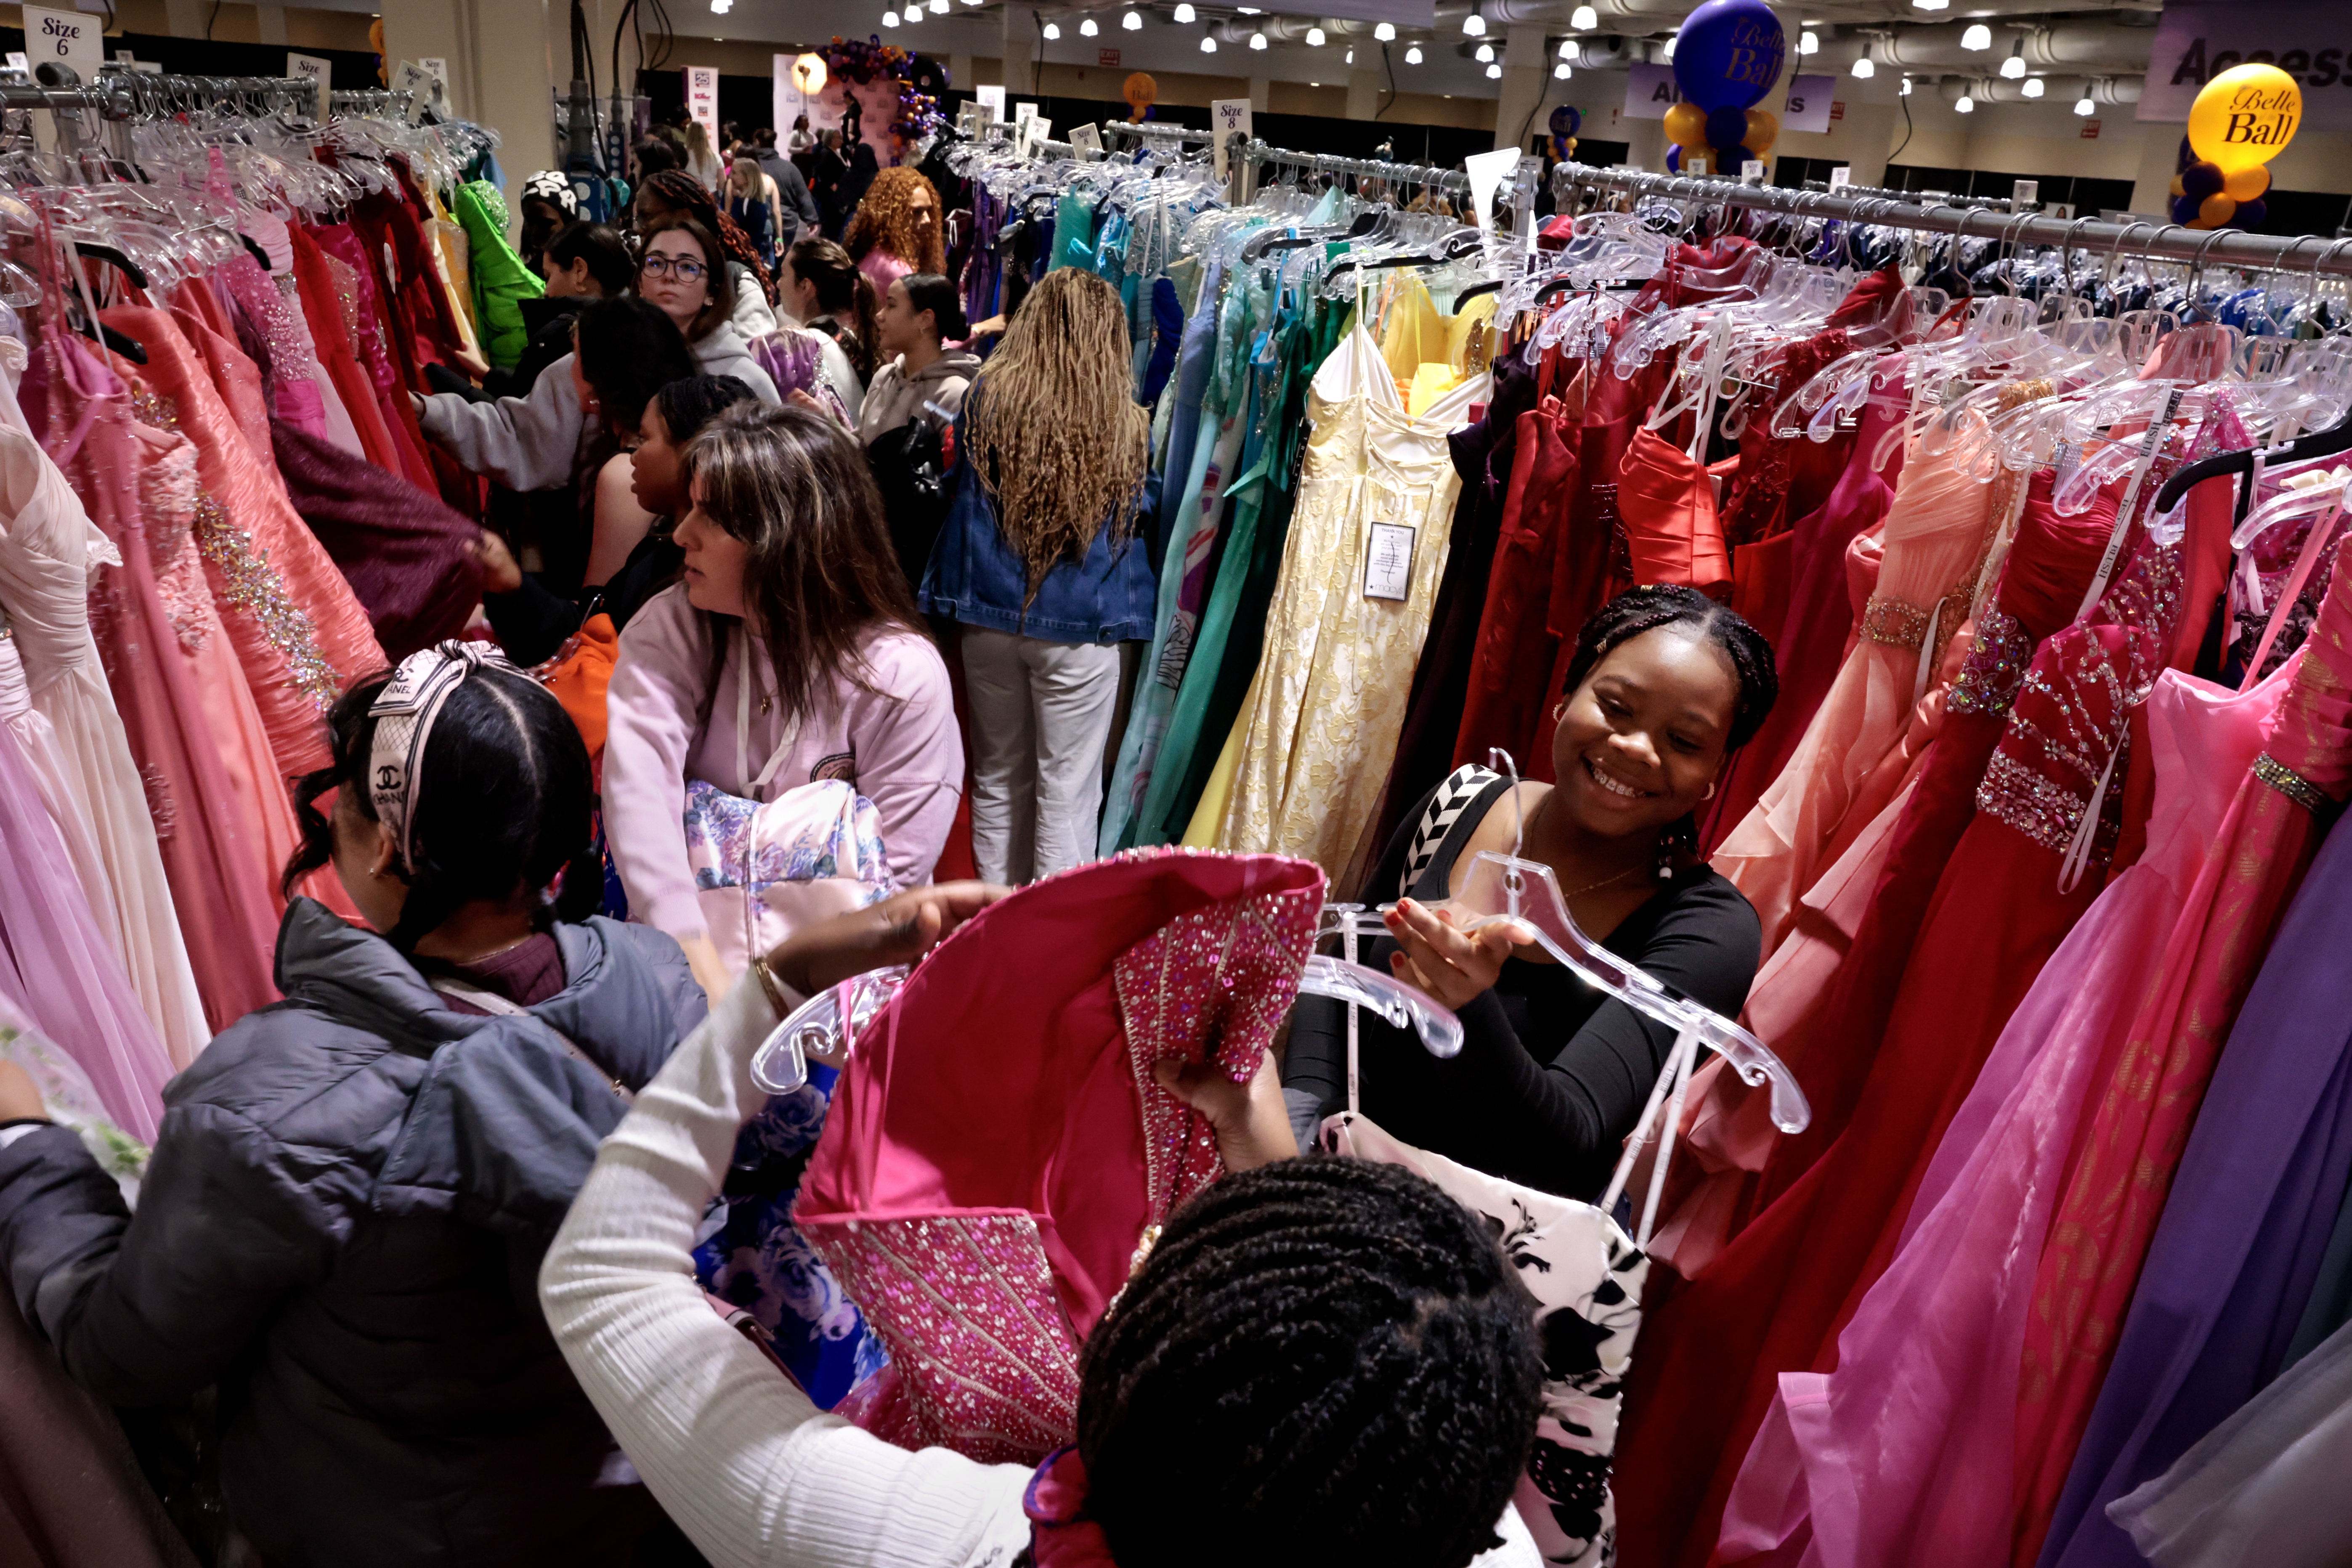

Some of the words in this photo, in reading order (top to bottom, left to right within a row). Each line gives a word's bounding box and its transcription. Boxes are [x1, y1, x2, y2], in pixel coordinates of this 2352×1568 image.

[42, 17, 80, 38] Size
[57, 39, 68, 56] 6
[1731, 24, 1785, 54] Belle
[298, 60, 320, 74] Size
[405, 67, 422, 81] Size
[1722, 48, 1784, 90] Ball
[2230, 90, 2295, 112] Belle
[1221, 105, 1243, 117] Size
[1228, 117, 1235, 129] 8
[2222, 113, 2293, 145] Ball
[1077, 130, 1091, 139] Size
[2099, 544, 2118, 578] BLUSH
